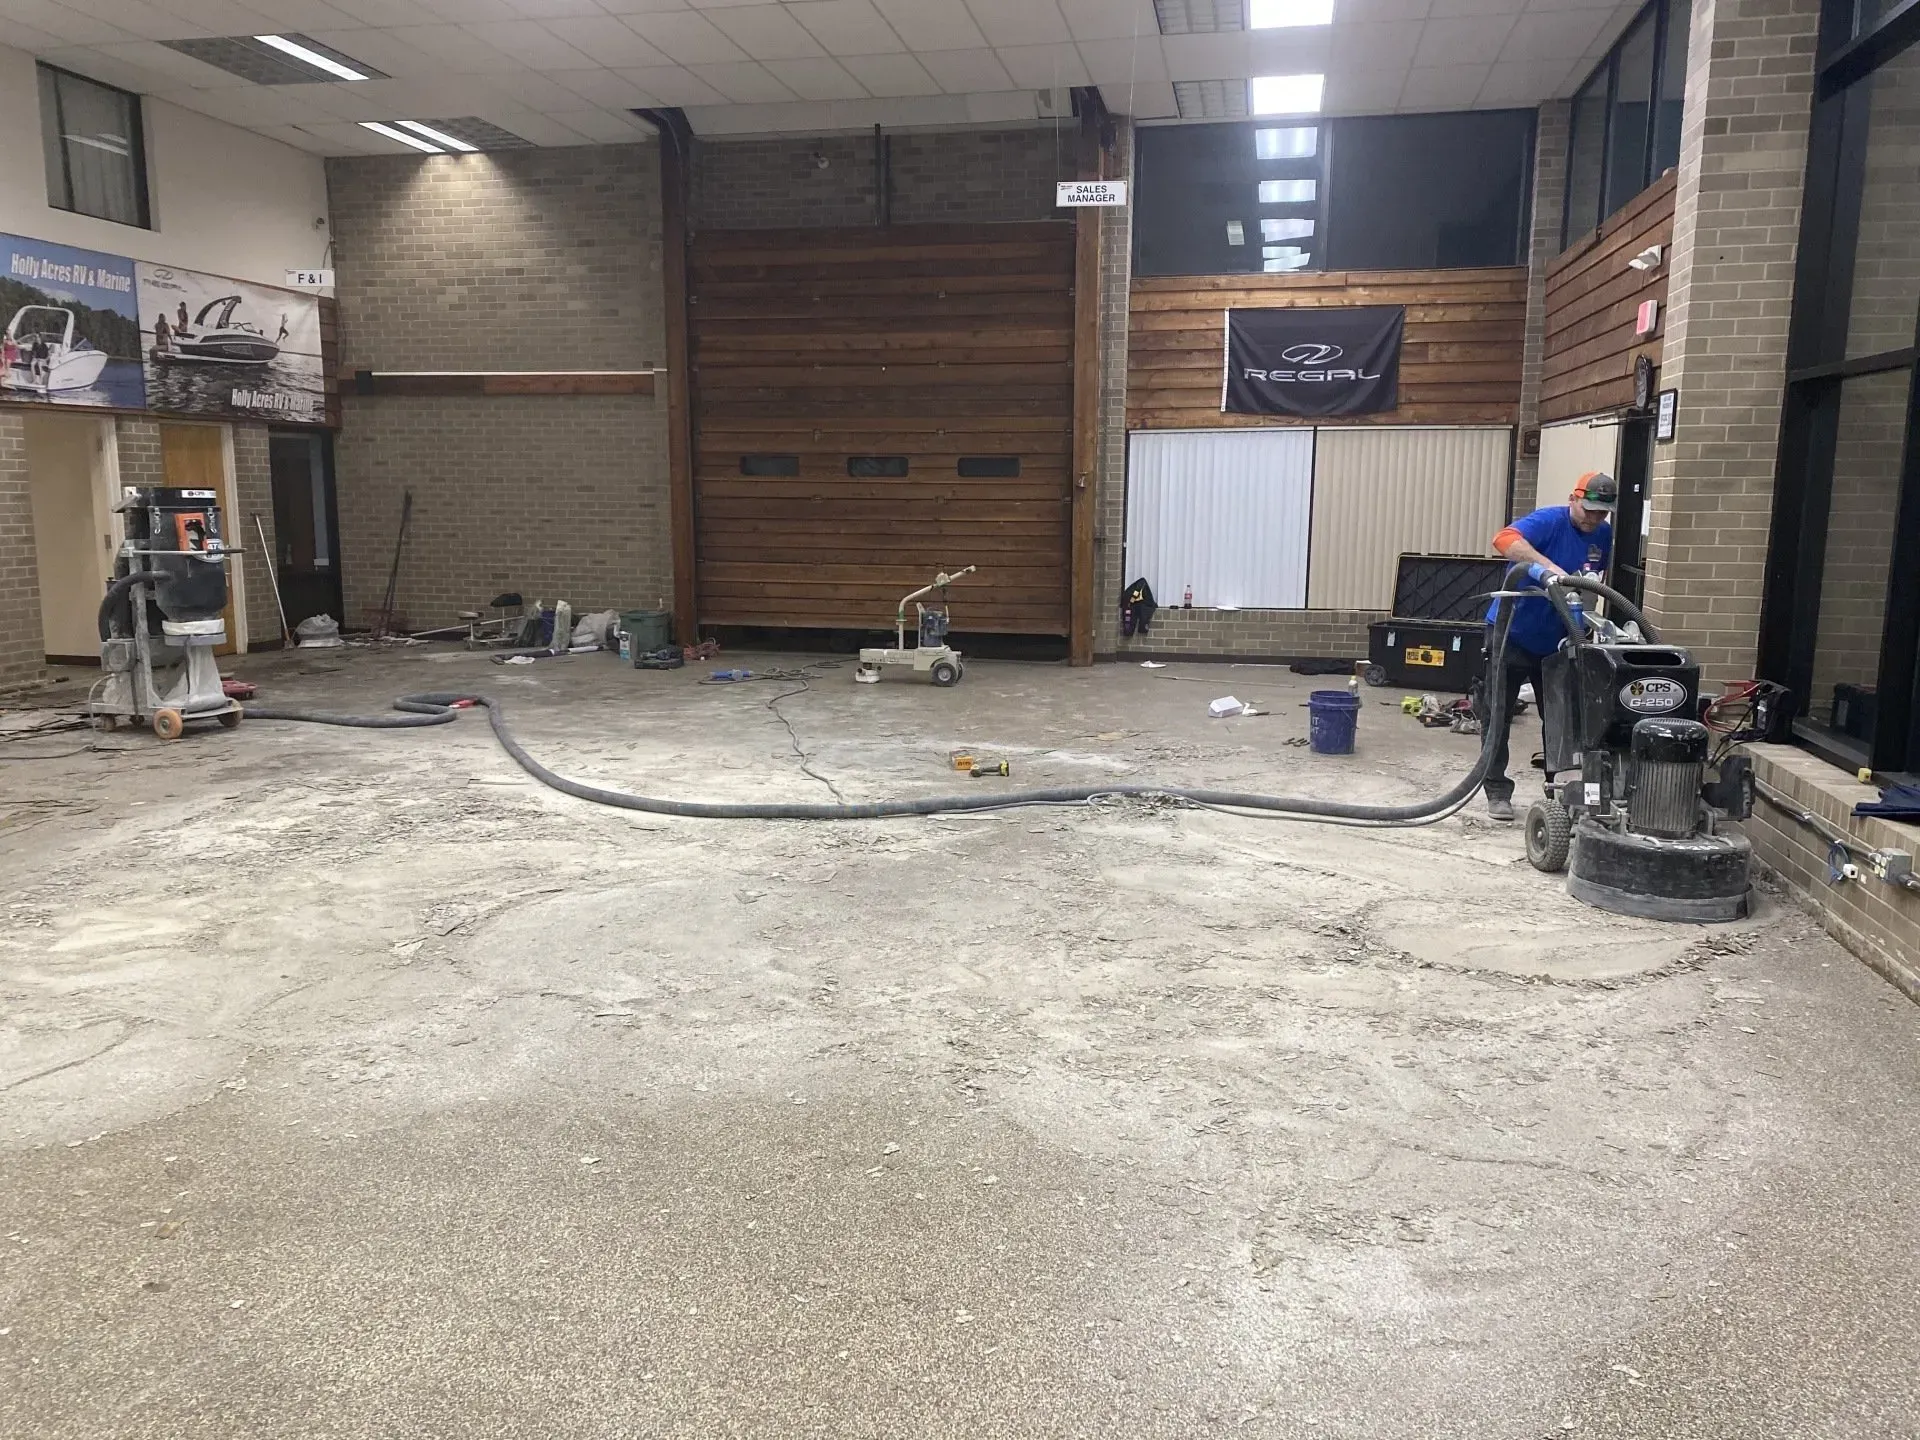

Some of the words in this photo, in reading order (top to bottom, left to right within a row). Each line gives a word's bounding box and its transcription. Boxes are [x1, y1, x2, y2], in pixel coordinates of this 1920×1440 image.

[1076, 185, 1107, 194] SALES
[1068, 194, 1115, 202] MANAGER
[11, 253, 40, 279] Holly
[41, 259, 72, 282] Acres
[72, 264, 88, 285] RV
[88, 270, 95, 286] &
[96, 268, 131, 292] Marine
[298, 273, 305, 283] F
[308, 273, 316, 283] &
[1243, 368, 1381, 382] REGAL
[232, 388, 252, 409] Holly
[251, 390, 274, 409] Acres
[1646, 683, 1671, 692] CPS
[1630, 698, 1673, 706] G-250
